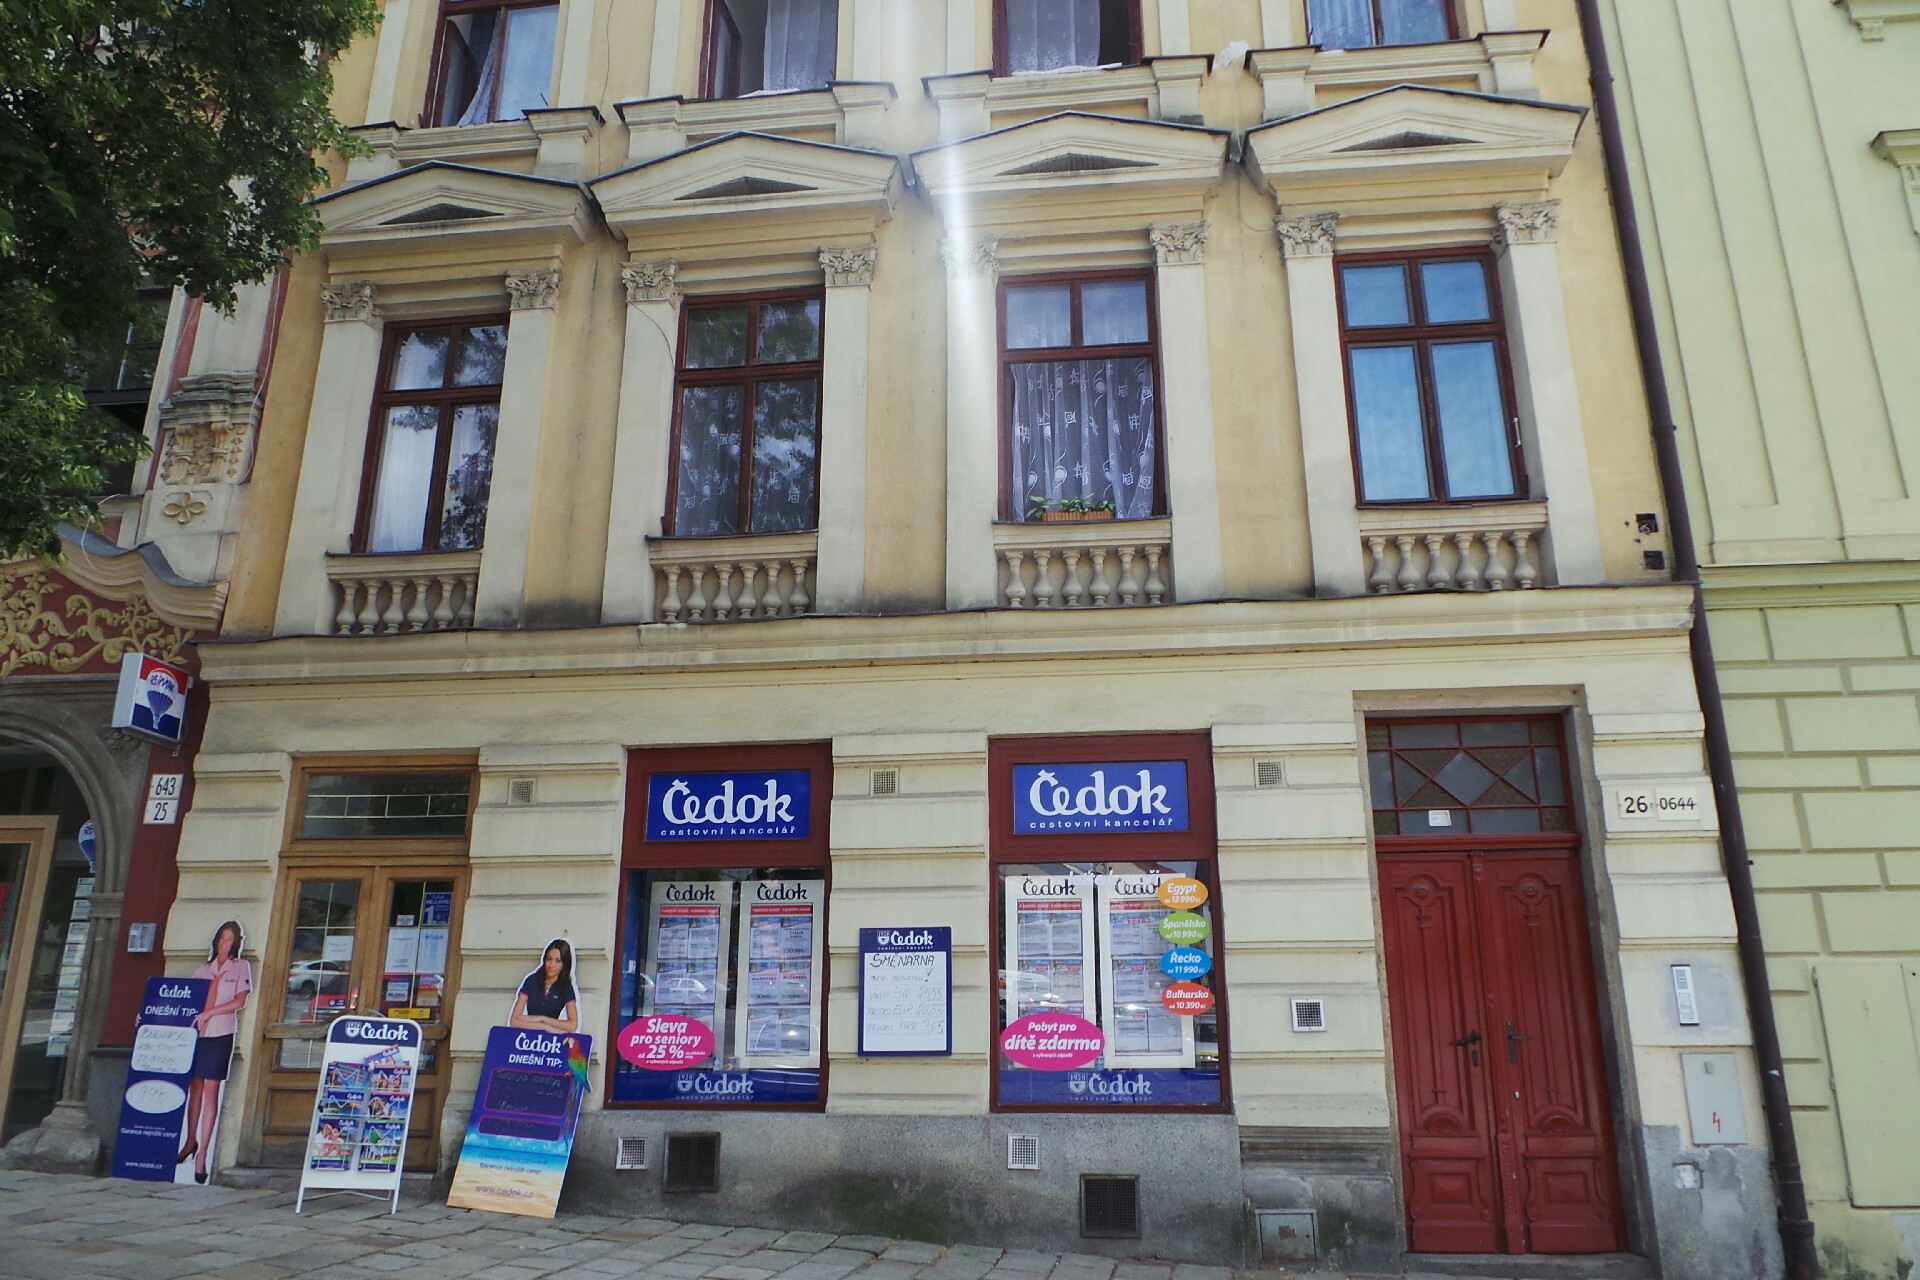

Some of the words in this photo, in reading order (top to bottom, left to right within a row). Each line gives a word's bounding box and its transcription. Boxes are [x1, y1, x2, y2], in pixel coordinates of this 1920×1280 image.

[150, 674, 176, 693] RE/MAX
[155, 777, 176, 796] 643
[1029, 769, 1172, 816] Čedok
[662, 779, 795, 824] Čedok
[1624, 796, 1648, 813] 26
[1659, 797, 1696, 810] 0644
[153, 802, 168, 821] 25
[661, 827, 724, 836] cestovní
[731, 825, 796, 835] kancelář
[1029, 819, 1097, 829] cestovní
[1104, 817, 1173, 828] kancelář
[666, 883, 715, 901] Čedok
[757, 882, 807, 900] Čedok
[1022, 878, 1076, 895] Čedok
[1167, 883, 1197, 895] Egypt
[1163, 918, 1206, 929] Španělsko
[891, 930, 934, 946] Čedok
[870, 952, 935, 968] SMĚNÁRNA
[1170, 951, 1202, 963] Řecko
[159, 984, 192, 999] Čedok
[1166, 990, 1209, 999] Bulharsko
[144, 1005, 181, 1016] DNEŠNÍ
[182, 1007, 199, 1018] TIP:
[360, 1022, 409, 1041] Čedok
[646, 1018, 688, 1034] Sleva
[1028, 1021, 1058, 1032] Pobyt
[1058, 1023, 1077, 1033] pro
[515, 1032, 562, 1054] Čedok
[630, 1034, 654, 1047] pro
[655, 1034, 702, 1048] seniory
[1005, 1034, 1037, 1051] dítě
[1037, 1034, 1101, 1051] zdarma
[646, 1045, 666, 1059] 25
[508, 1053, 546, 1066] DNEŠNÍ
[546, 1057, 563, 1068] TIP:
[694, 1073, 754, 1094] Čedok
[1088, 1072, 1153, 1095] Čedok
[475, 1185, 534, 1198] www.cedok.cz
